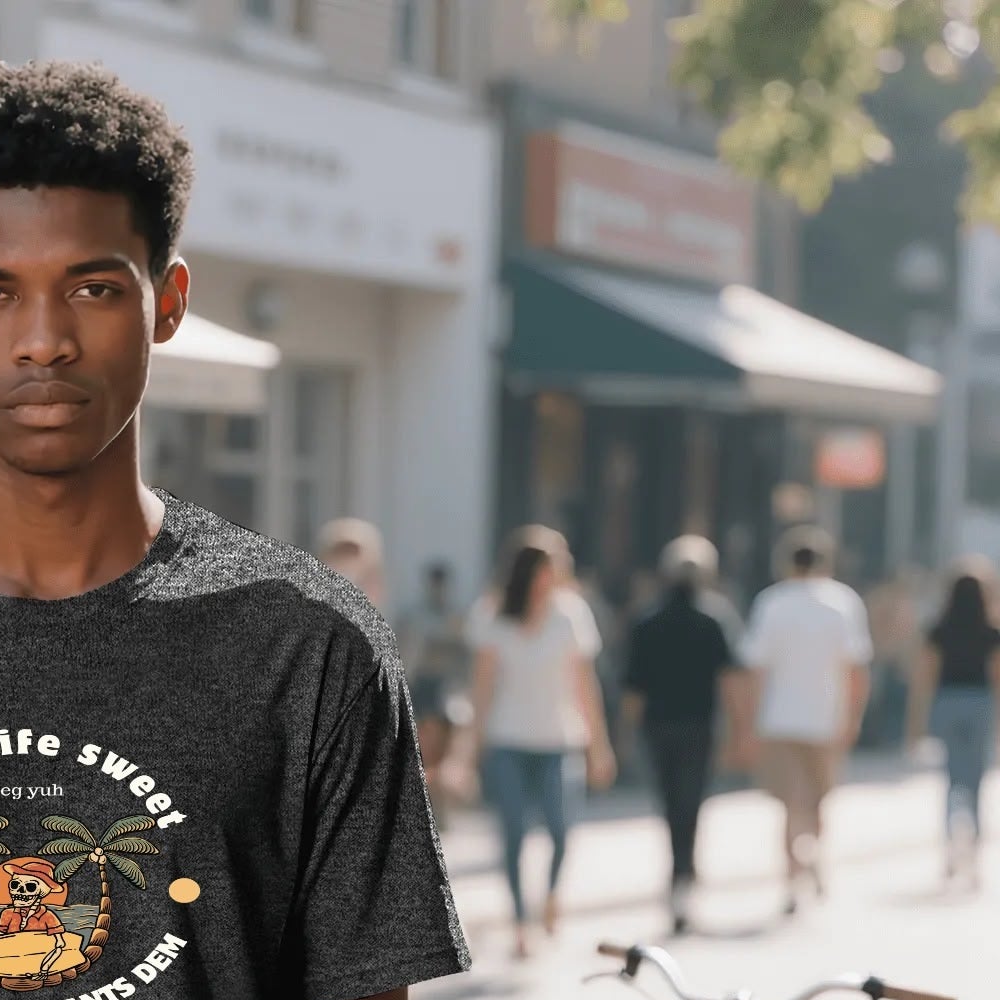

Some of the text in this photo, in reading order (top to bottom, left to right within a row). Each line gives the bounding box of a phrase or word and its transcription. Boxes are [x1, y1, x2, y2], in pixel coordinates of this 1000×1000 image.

[28, 783, 64, 799] yuh
[76, 743, 187, 829] sweet
[130, 932, 188, 985] DEM
